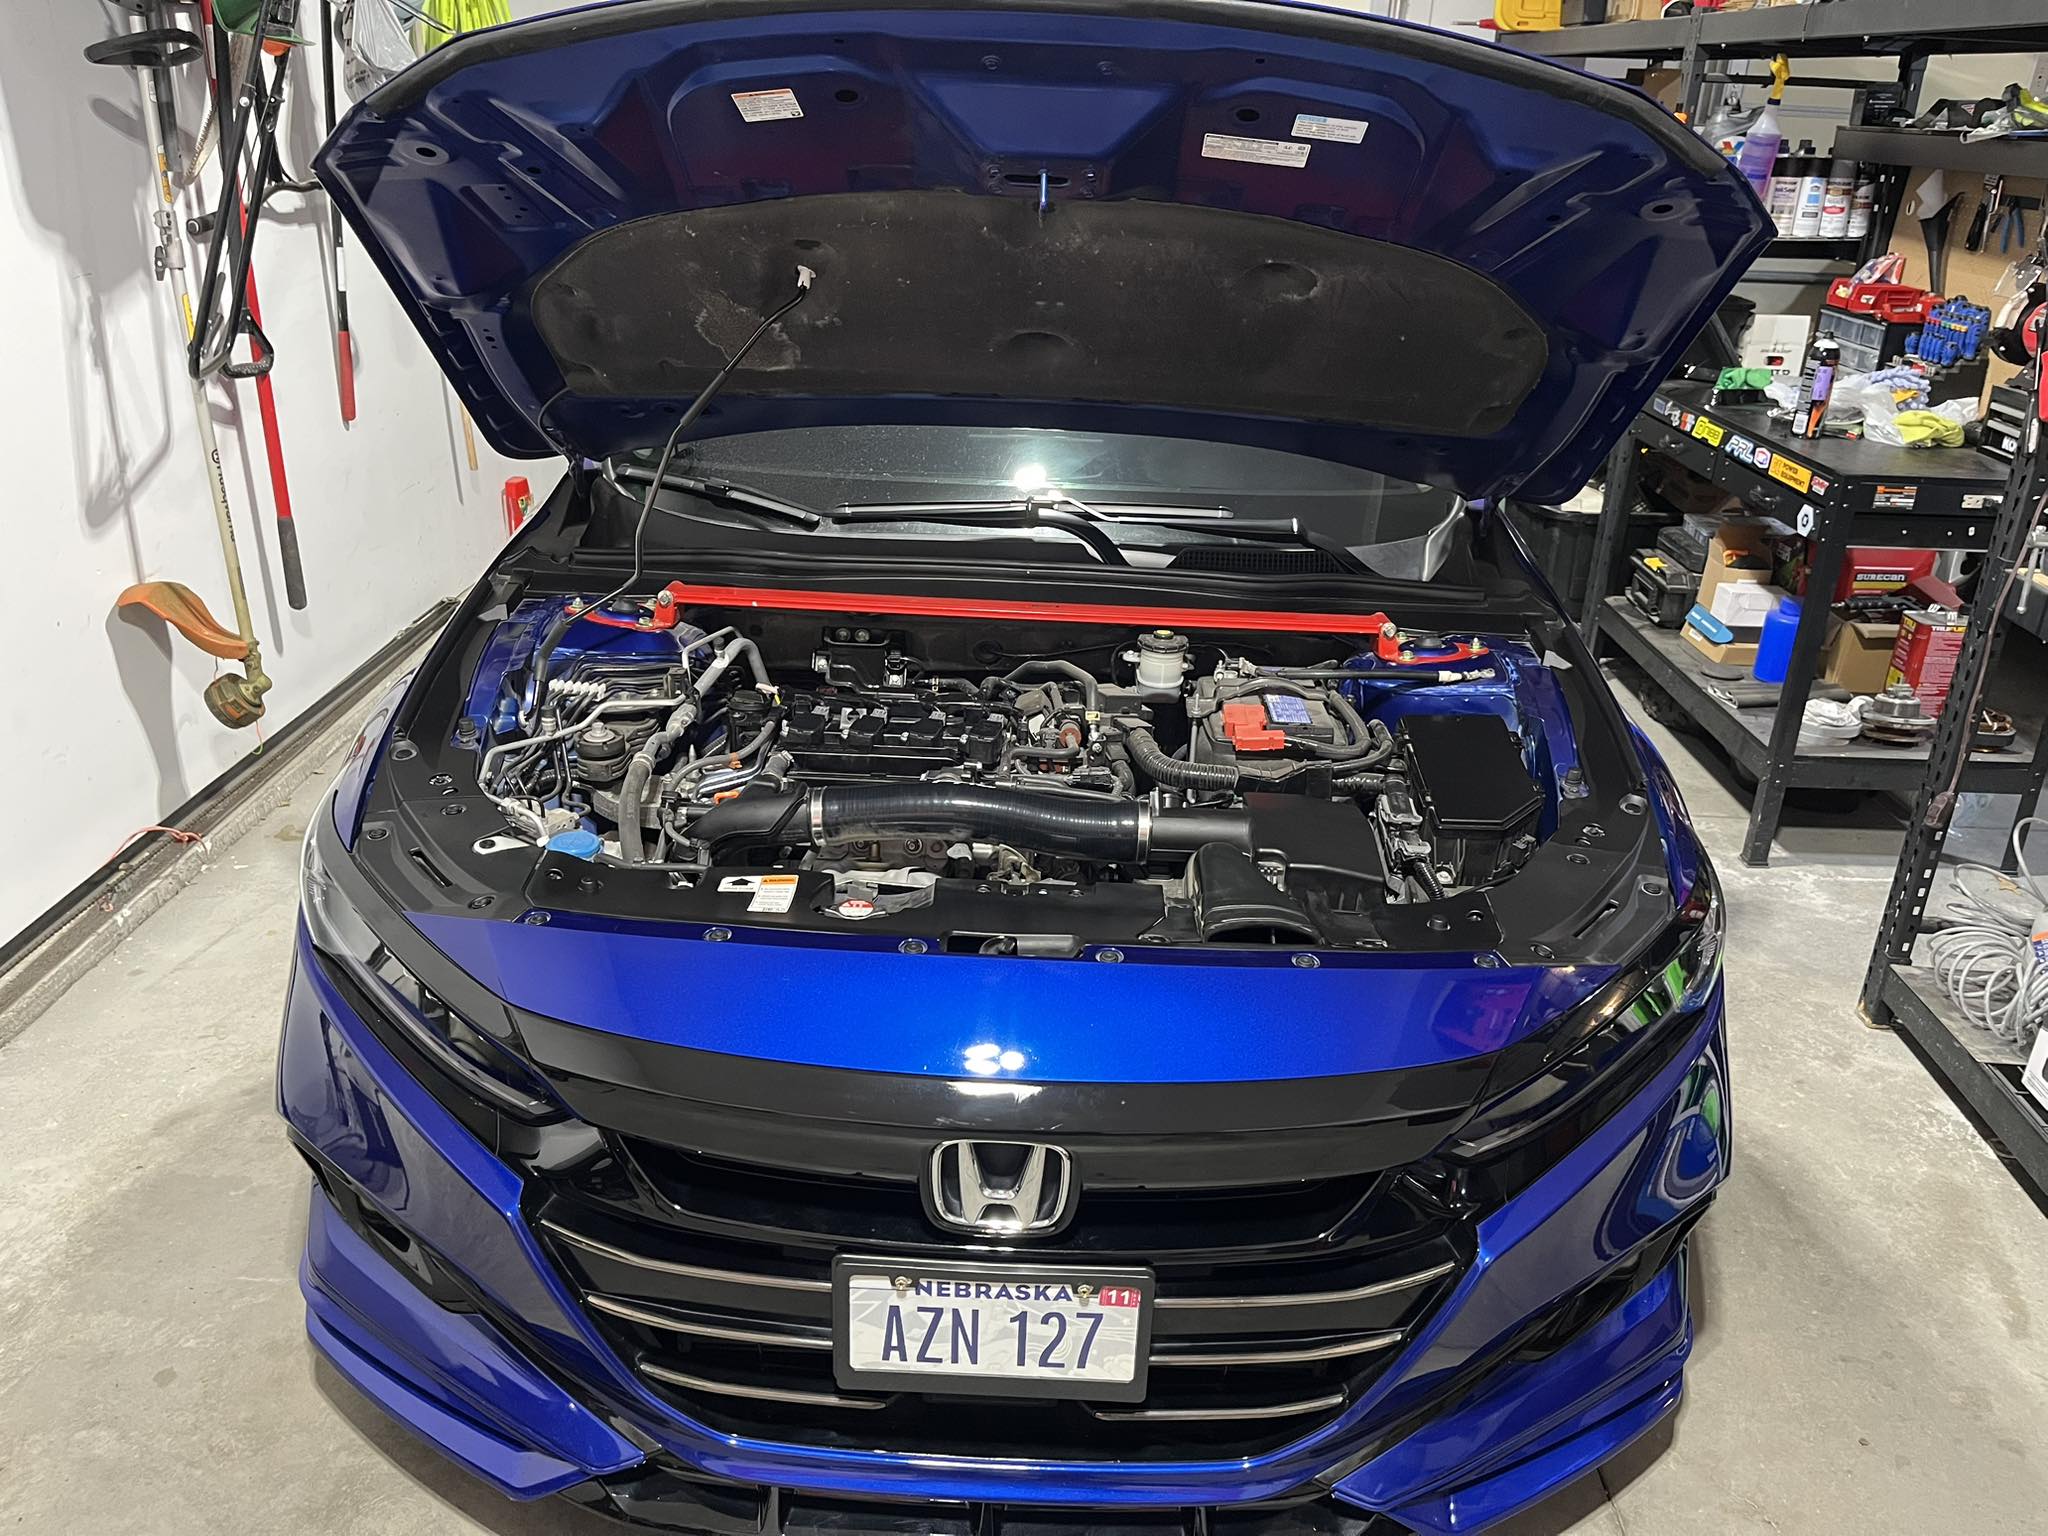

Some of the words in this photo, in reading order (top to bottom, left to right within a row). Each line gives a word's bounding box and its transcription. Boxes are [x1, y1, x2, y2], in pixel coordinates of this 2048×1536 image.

[2001, 435, 2018, 453] KO
[914, 1280, 1073, 1303] NEBRASKA
[1108, 1289, 1131, 1305] 11
[881, 1304, 980, 1366] AZN
[1009, 1310, 1104, 1370] 127
